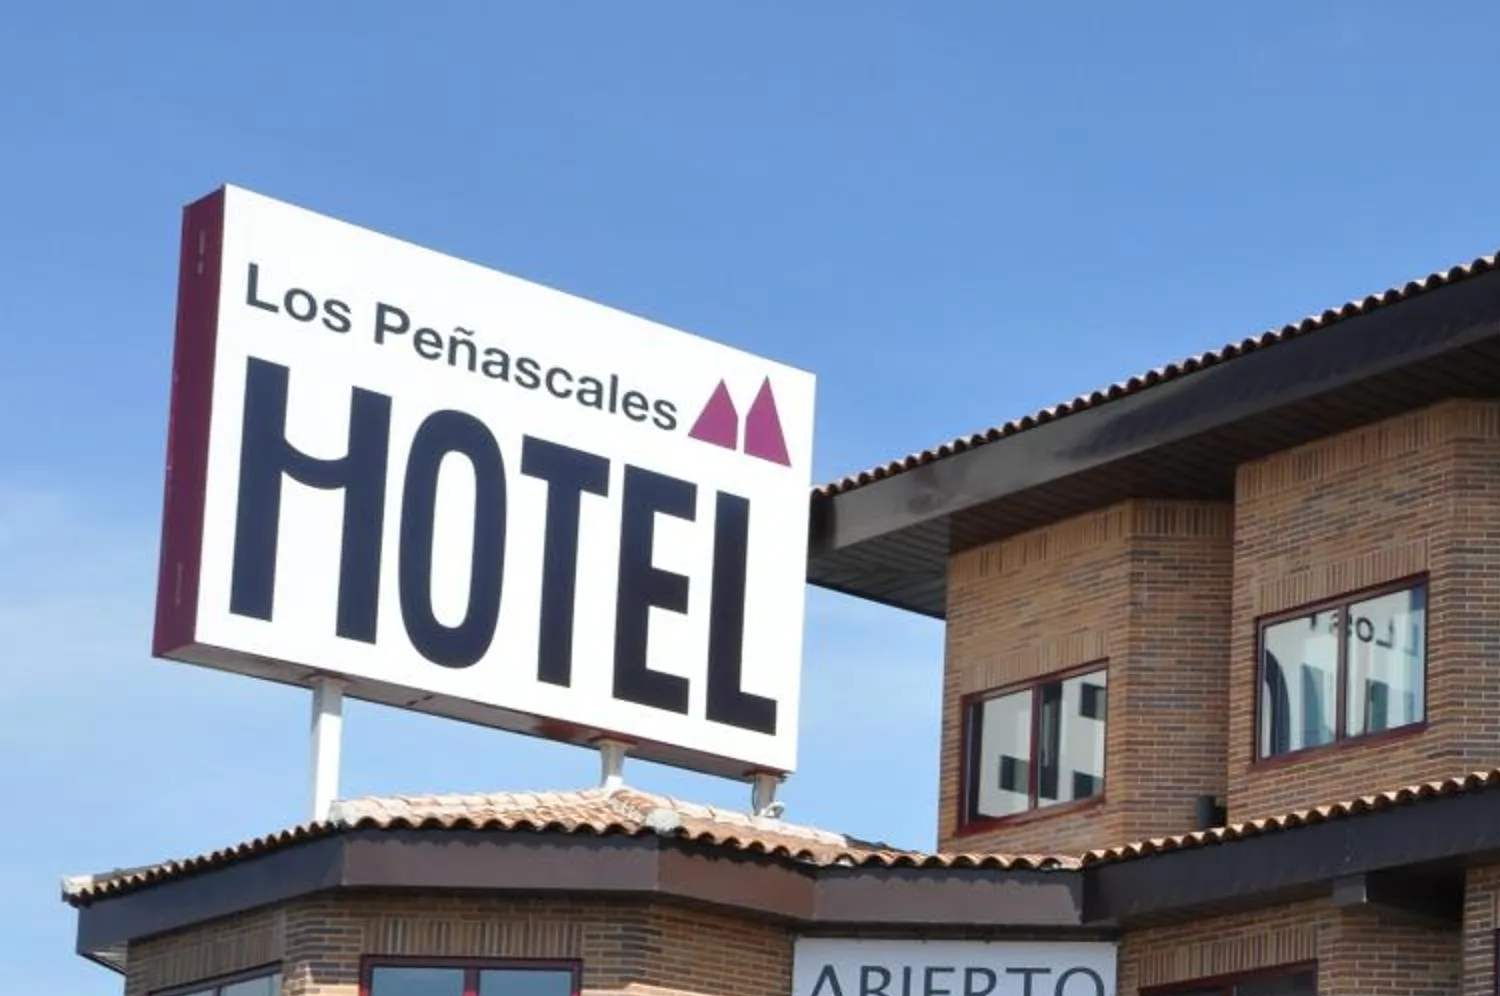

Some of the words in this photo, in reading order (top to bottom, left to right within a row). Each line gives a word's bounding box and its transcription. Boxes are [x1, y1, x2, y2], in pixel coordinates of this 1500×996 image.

[245, 262, 353, 334] Los
[374, 302, 679, 432] Peñascales
[229, 355, 778, 736] HOTEL
